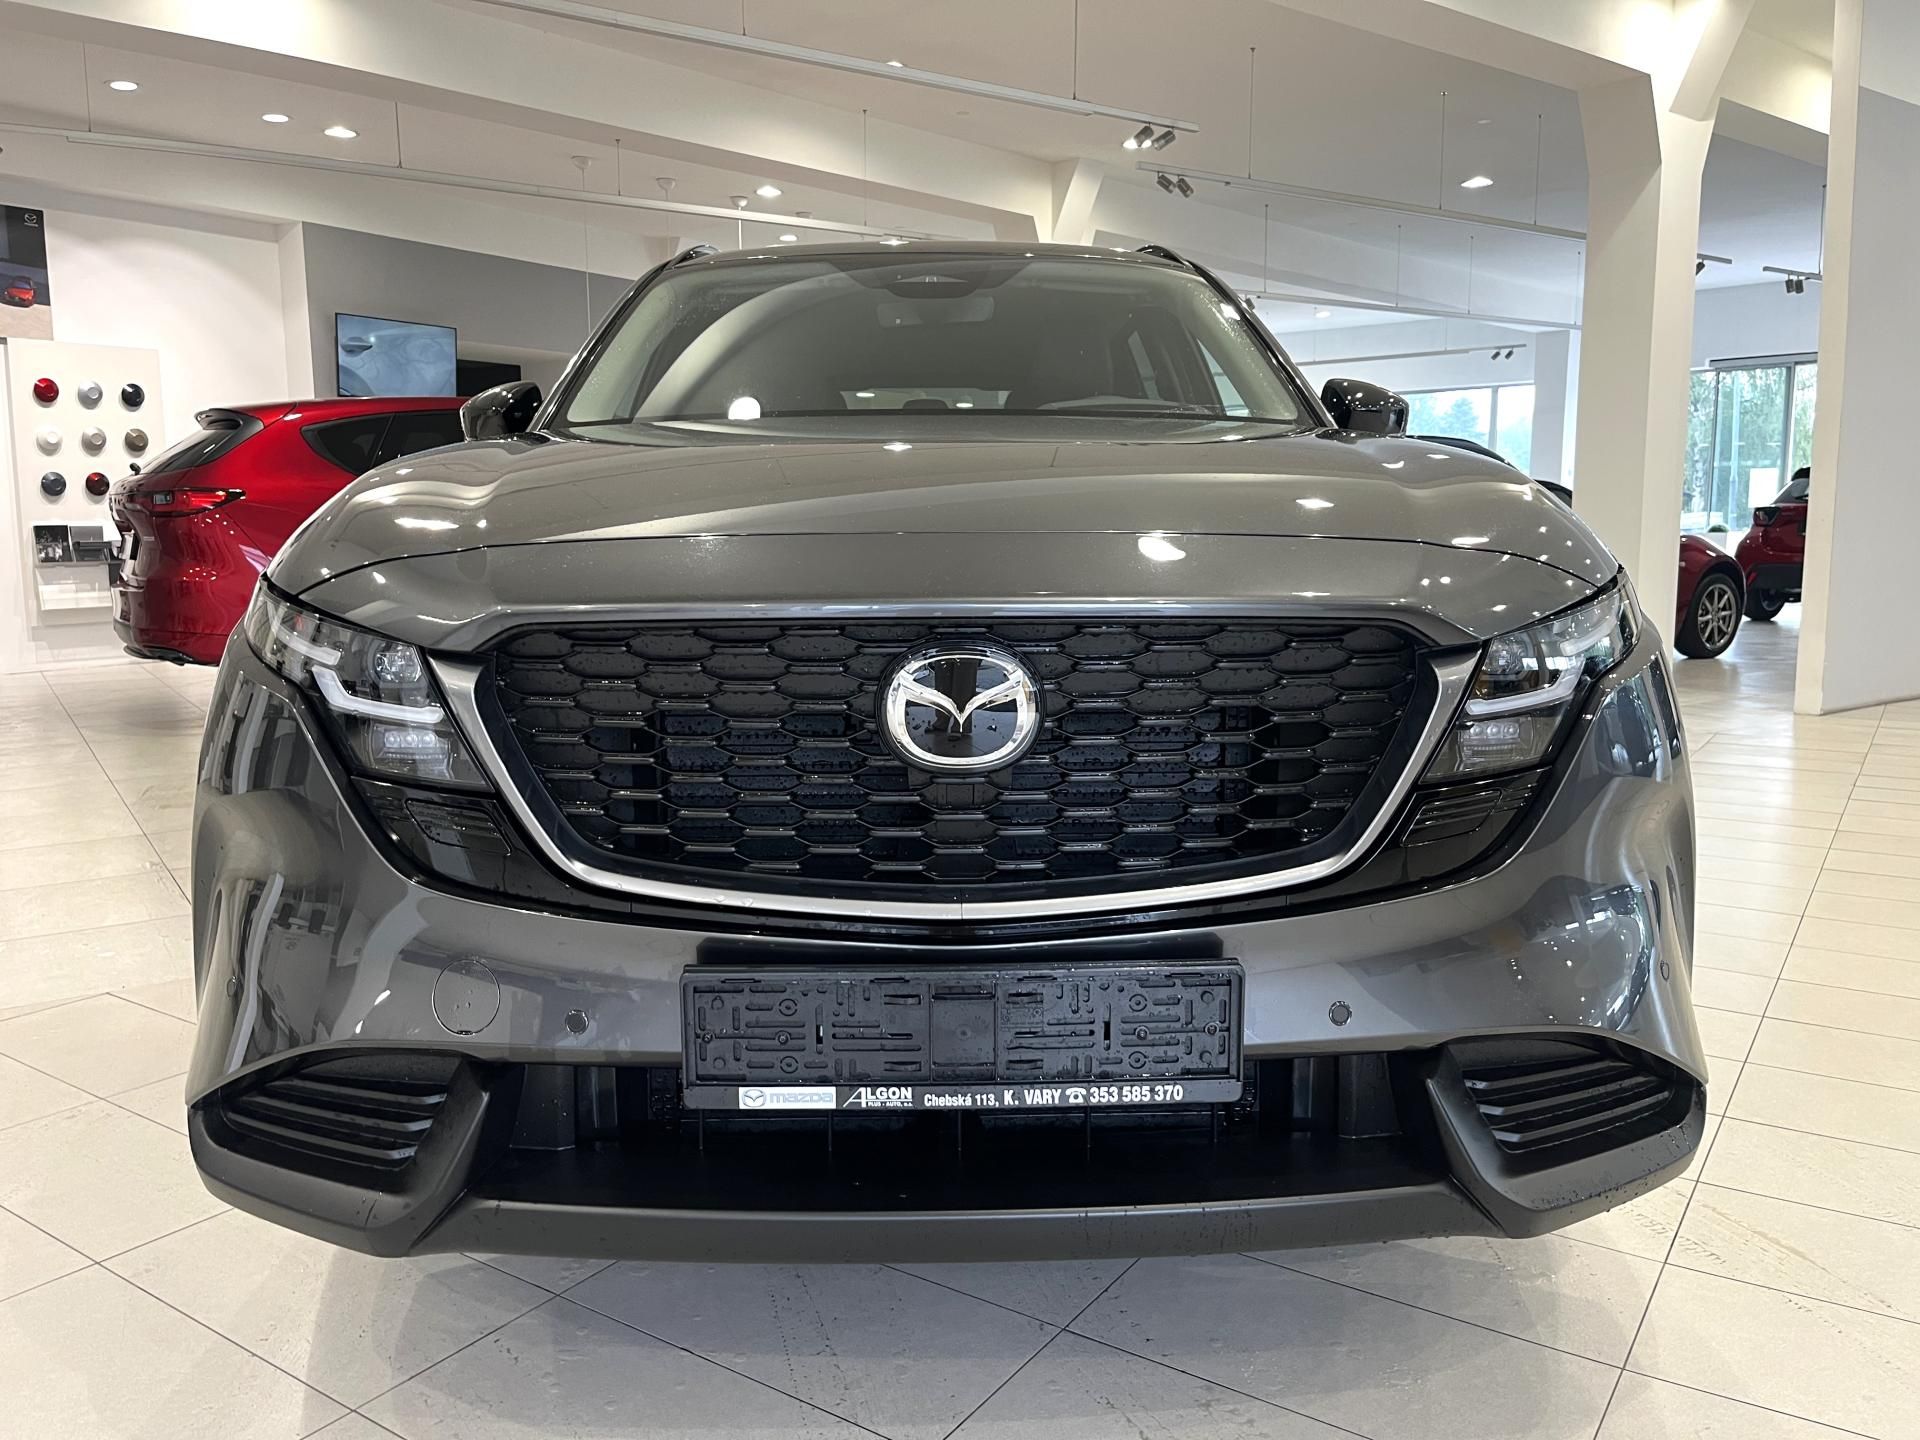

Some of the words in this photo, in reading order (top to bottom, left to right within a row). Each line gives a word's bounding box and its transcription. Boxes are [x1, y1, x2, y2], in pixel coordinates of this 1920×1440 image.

[769, 1092, 833, 1104] mazda
[842, 1086, 913, 1108] ALGON
[923, 1093, 972, 1107] Chebská
[974, 1093, 1000, 1108] 113,
[1003, 1089, 1019, 1106] K.
[1023, 1088, 1062, 1105] VARY
[1089, 1086, 1119, 1103] 353
[1121, 1085, 1151, 1102] 585
[1154, 1084, 1184, 1101] 370
